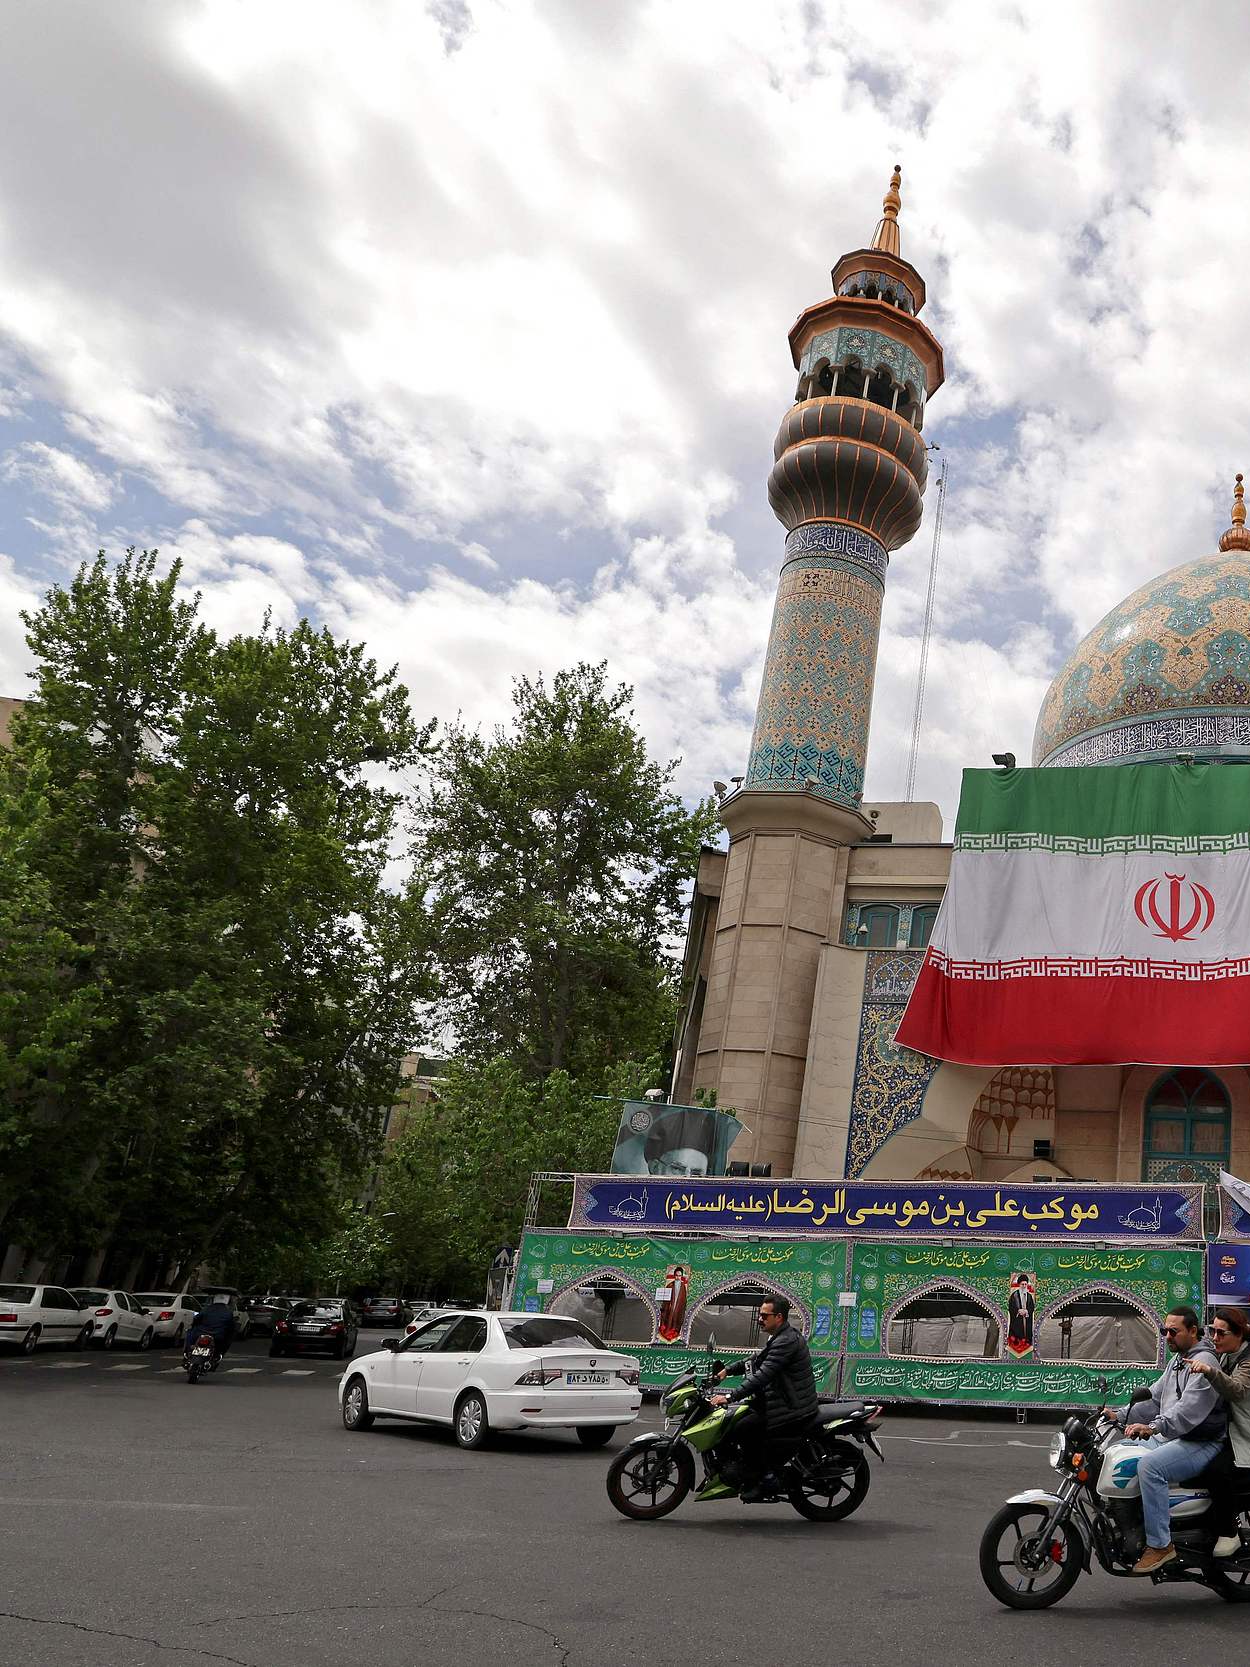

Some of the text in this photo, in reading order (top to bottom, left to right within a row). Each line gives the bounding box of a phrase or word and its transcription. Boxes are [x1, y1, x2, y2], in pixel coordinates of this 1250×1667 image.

[845, 1200, 930, 1227] موسی
[930, 1194, 965, 1227] بن
[966, 1191, 1020, 1228] علی
[1022, 1196, 1099, 1231] موکب
